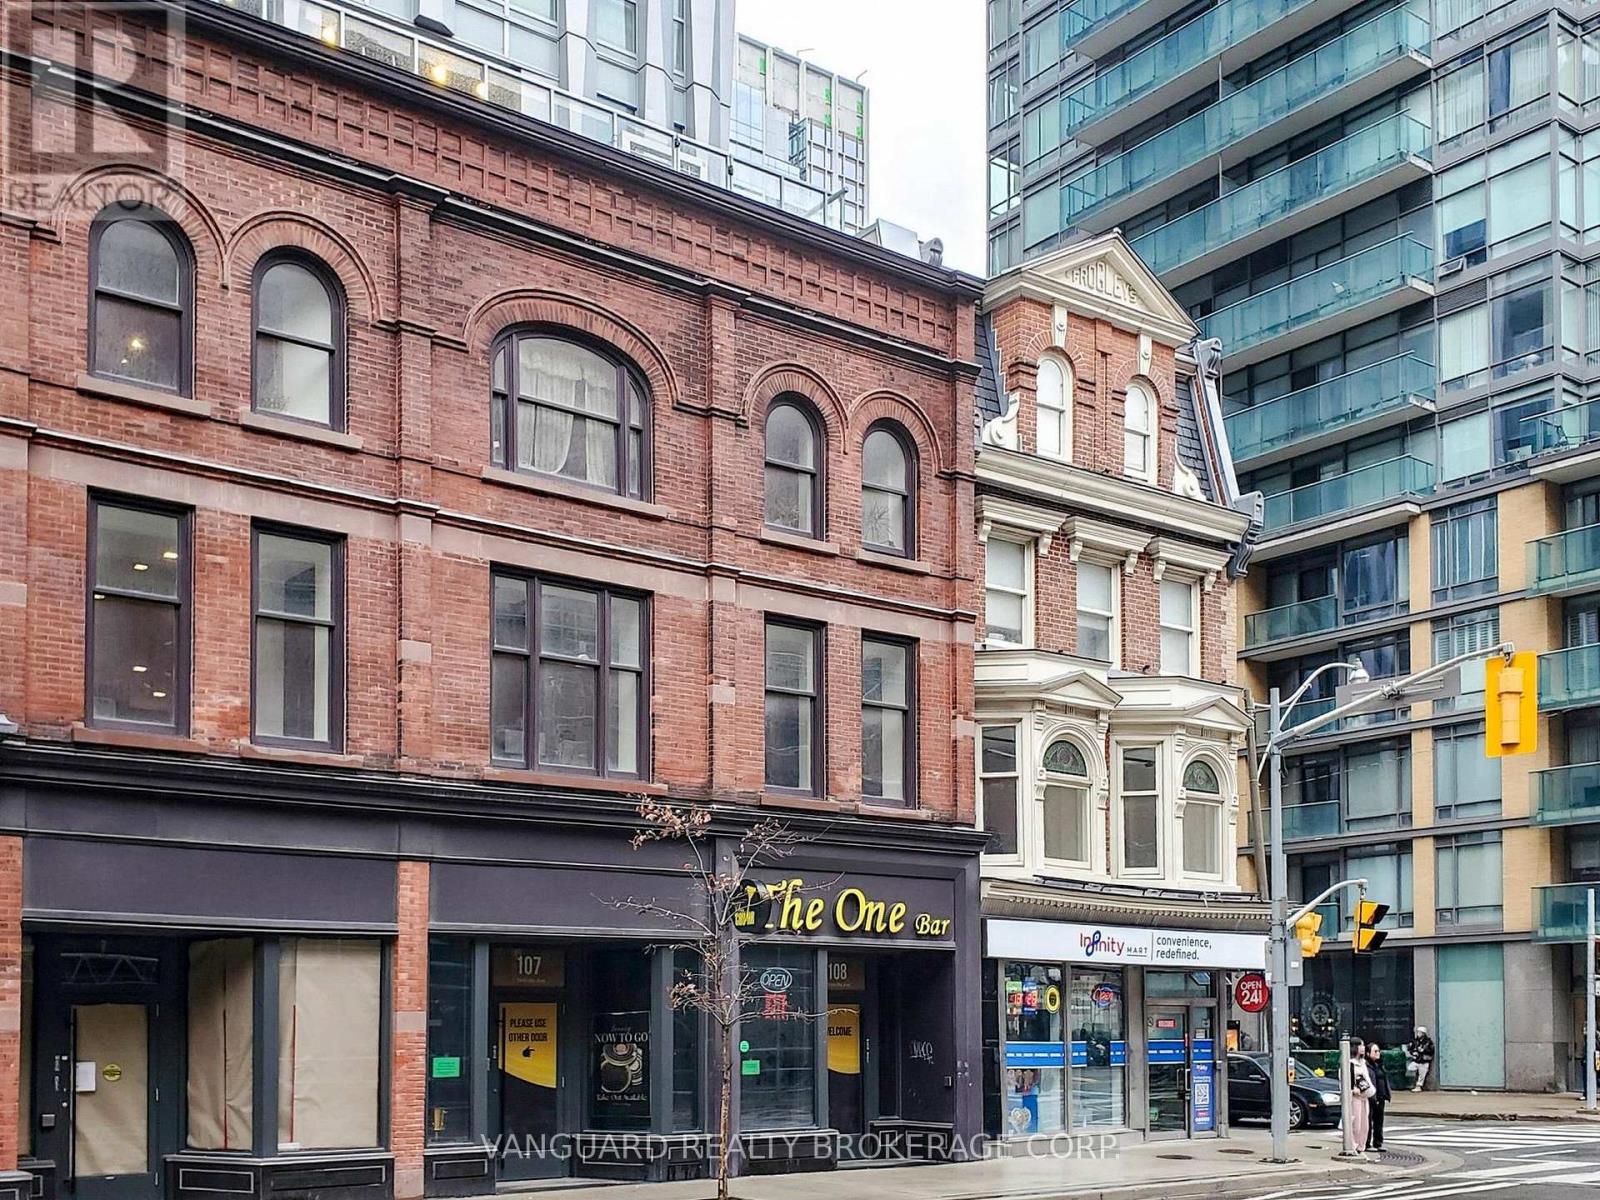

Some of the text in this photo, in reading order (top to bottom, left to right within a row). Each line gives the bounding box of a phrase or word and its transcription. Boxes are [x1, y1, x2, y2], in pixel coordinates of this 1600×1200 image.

[834, 888, 906, 933] One
[915, 914, 951, 936] Bar
[1156, 936, 1212, 950] convenience,
[1156, 949, 1200, 960] redefined.
[517, 956, 542, 975] 107
[828, 963, 847, 980] 108
[762, 973, 790, 987] OPEN
[1240, 980, 1263, 990] OPEN
[510, 1018, 547, 1028] PLEASE USE
[508, 1032, 548, 1042] OTHER DOOR
[594, 1032, 649, 1043] NOW TO GO
